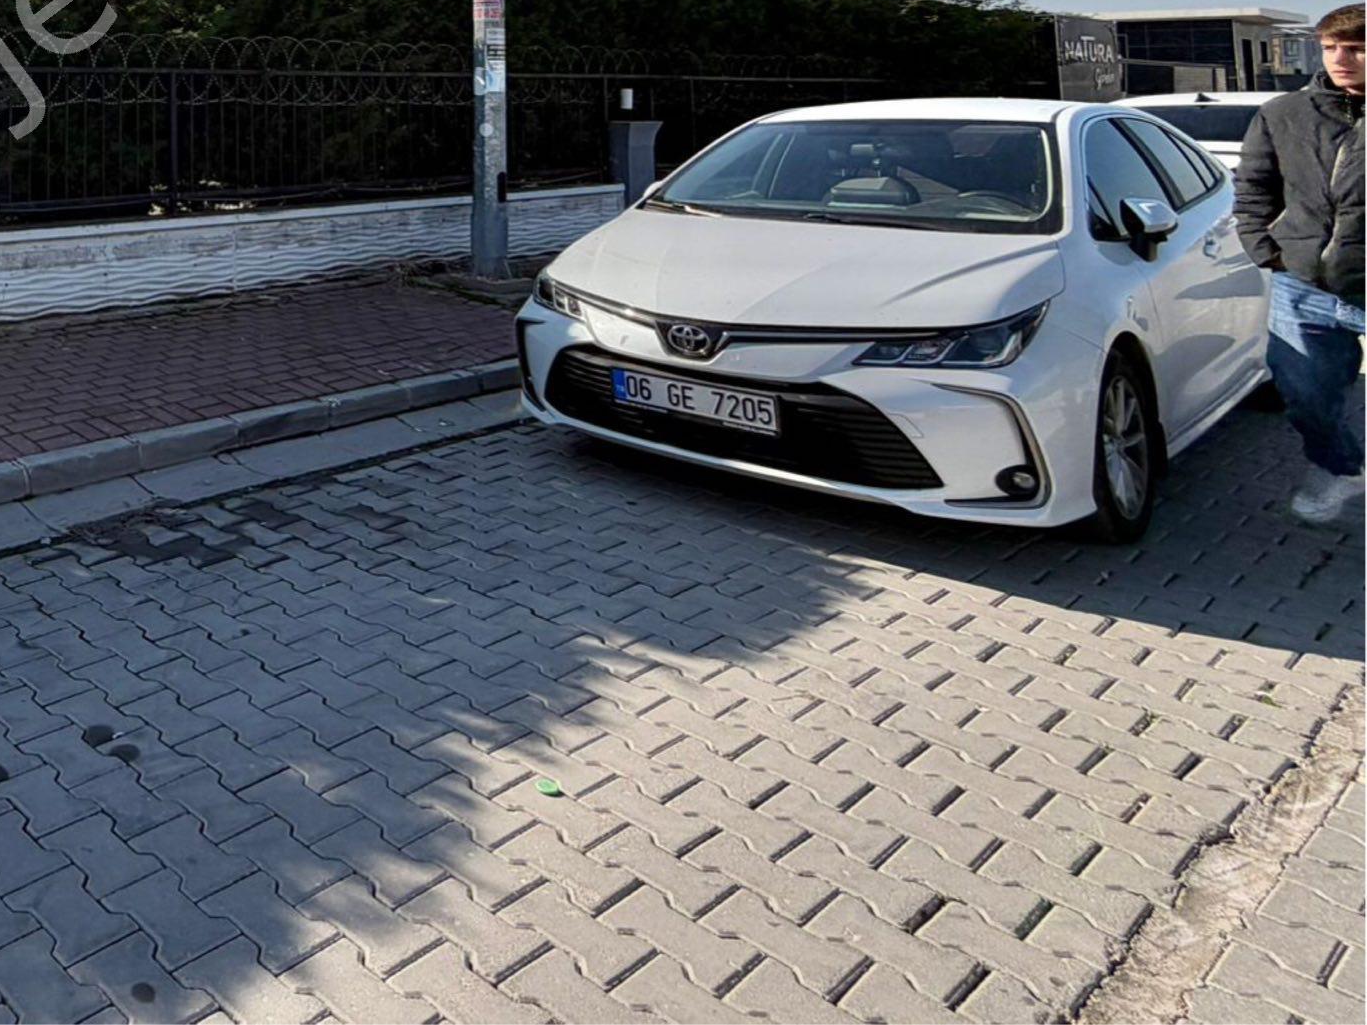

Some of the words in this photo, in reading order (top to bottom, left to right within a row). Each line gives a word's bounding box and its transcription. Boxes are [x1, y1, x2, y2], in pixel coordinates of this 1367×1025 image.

[1064, 35, 1114, 63] NATURA
[626, 375, 652, 401] 06
[667, 383, 695, 411] GE
[711, 391, 772, 425] 7205
